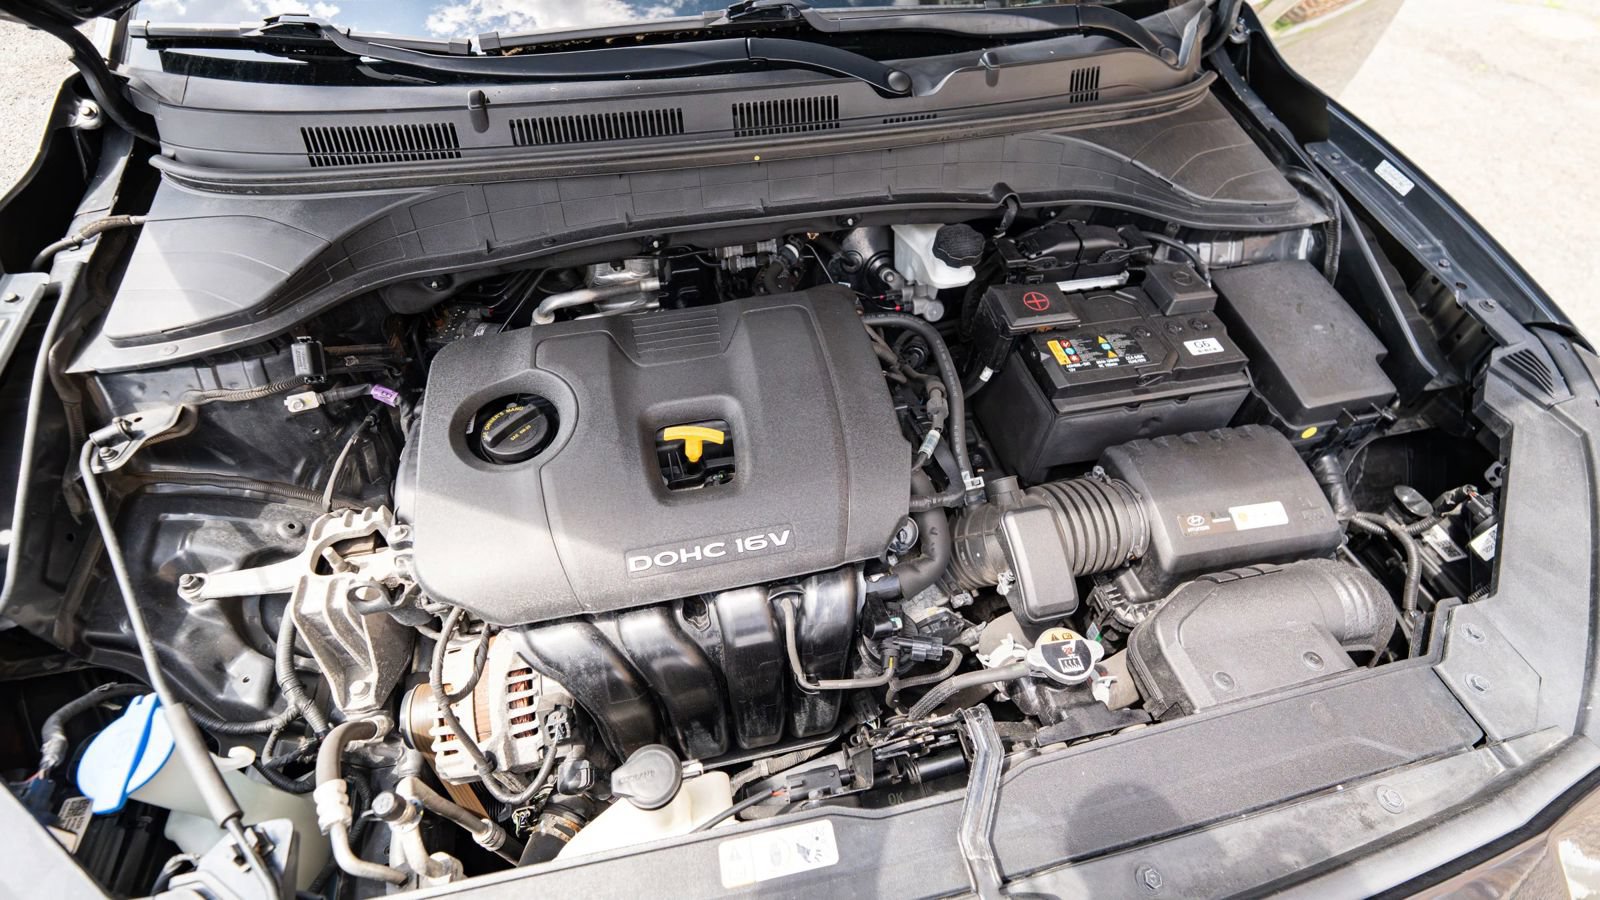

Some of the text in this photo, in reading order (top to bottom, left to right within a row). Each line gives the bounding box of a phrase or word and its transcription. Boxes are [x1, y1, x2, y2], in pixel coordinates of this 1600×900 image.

[1193, 340, 1211, 349] G6
[628, 529, 791, 573] DOHC 16V
[887, 791, 905, 806] OK
